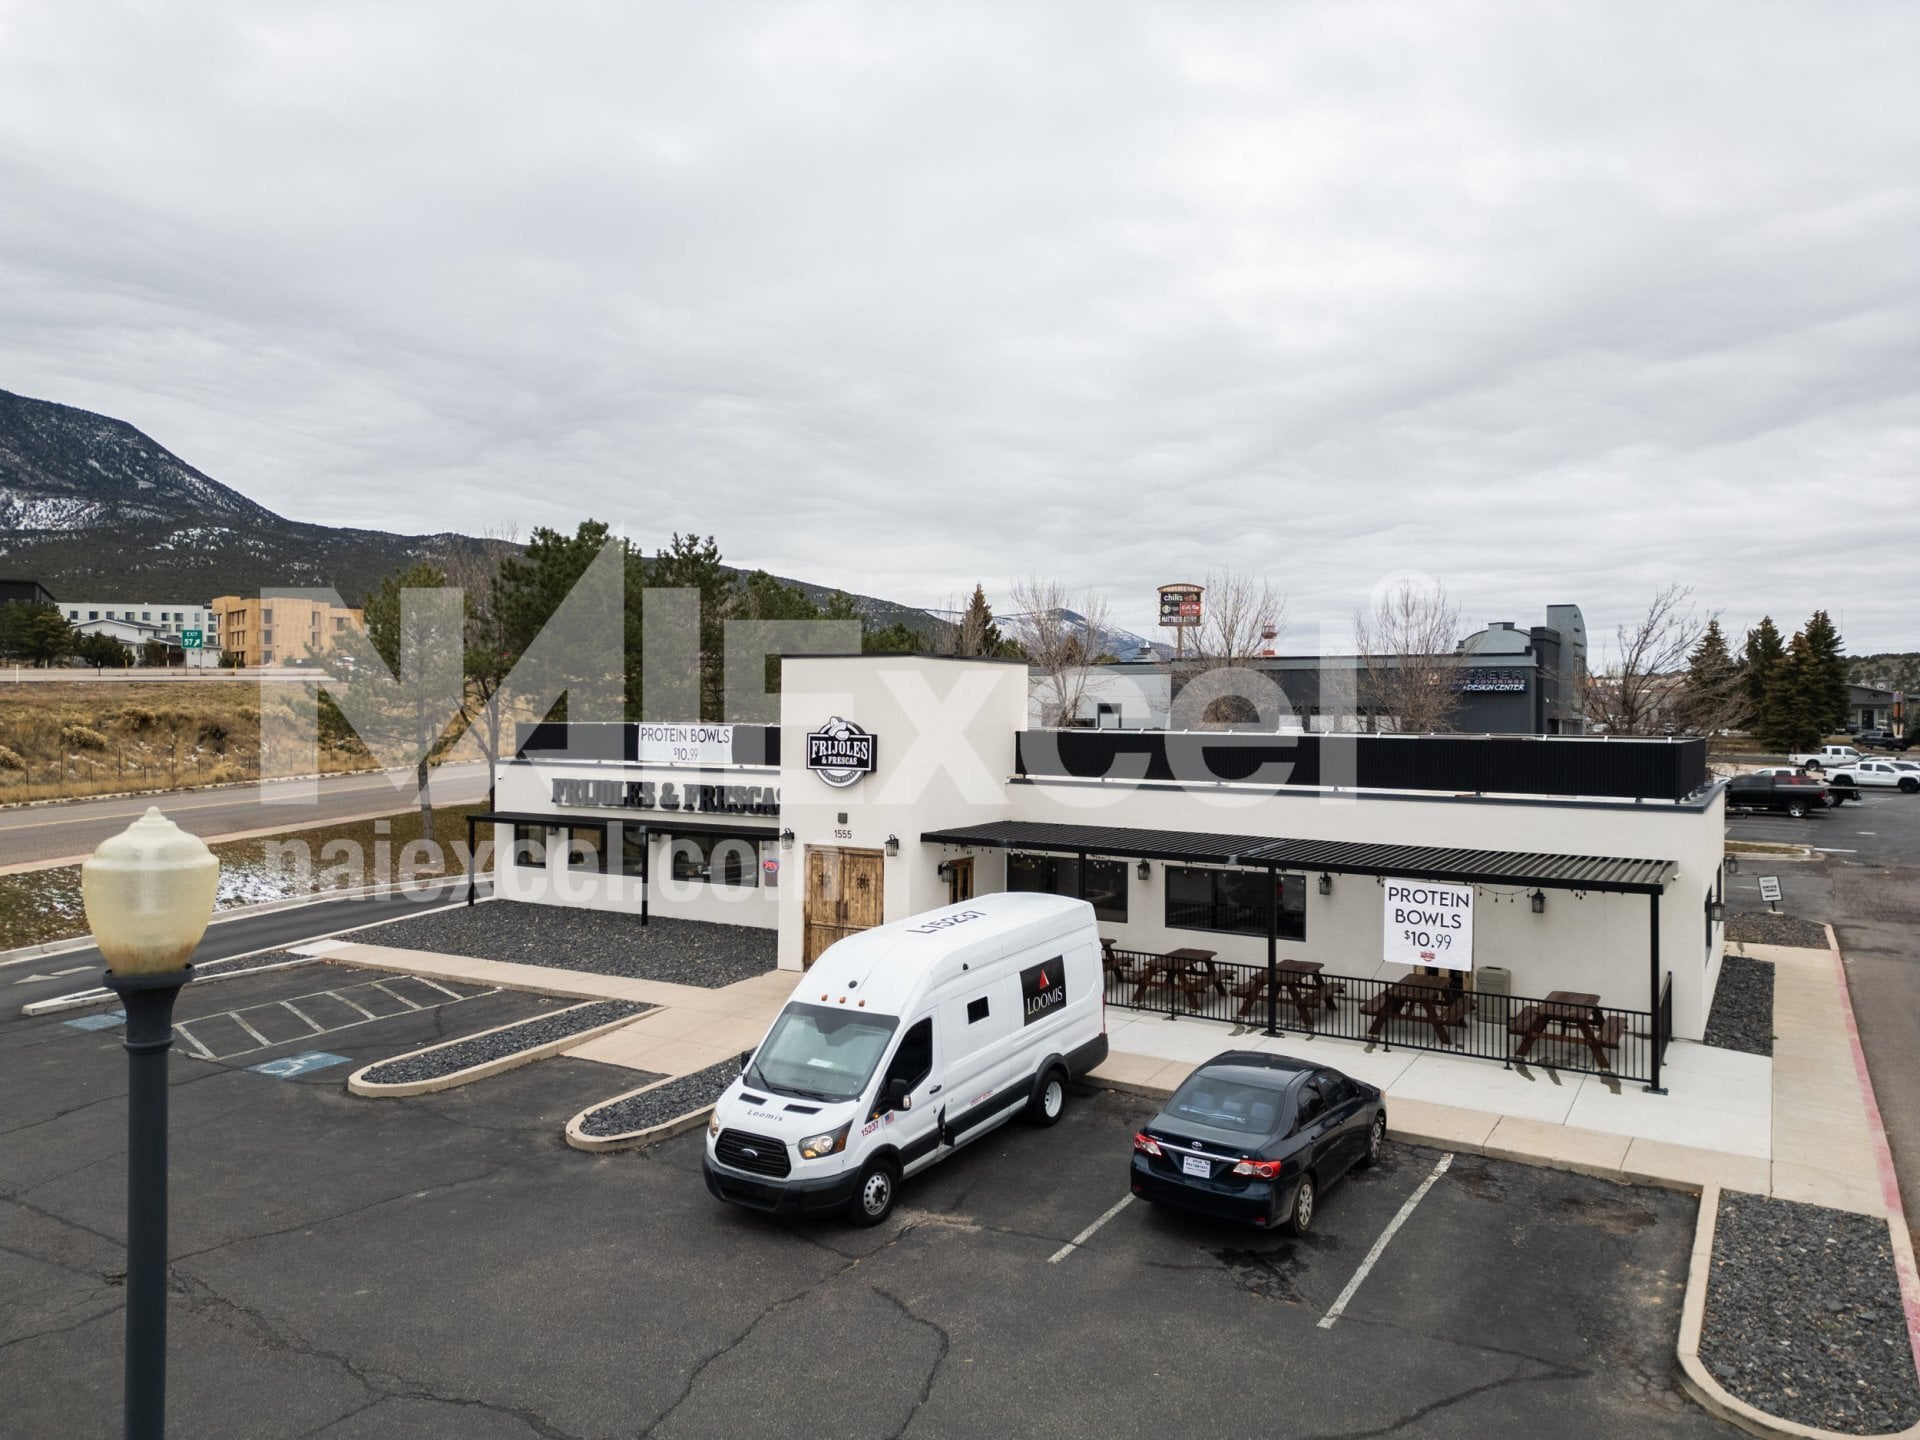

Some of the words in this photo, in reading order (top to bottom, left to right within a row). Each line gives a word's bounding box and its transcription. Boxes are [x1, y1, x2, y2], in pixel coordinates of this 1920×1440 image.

[641, 727, 688, 743] PROTEIN
[690, 728, 730, 744] BOWLS
[673, 747, 699, 761] $10.99
[811, 740, 868, 760] FRIJOLES
[821, 755, 828, 764] &
[828, 756, 858, 765] FRESCAS
[659, 782, 681, 810] &
[834, 829, 852, 839] 1555
[1388, 887, 1469, 908] PROTEIN
[906, 910, 987, 934] L15237
[1395, 909, 1462, 929] BOWLS
[1404, 930, 1452, 950] $10.99
[1027, 986, 1063, 1015] LOOMIS
[747, 1109, 784, 1122] Loomis
[861, 1121, 879, 1137] 15237
